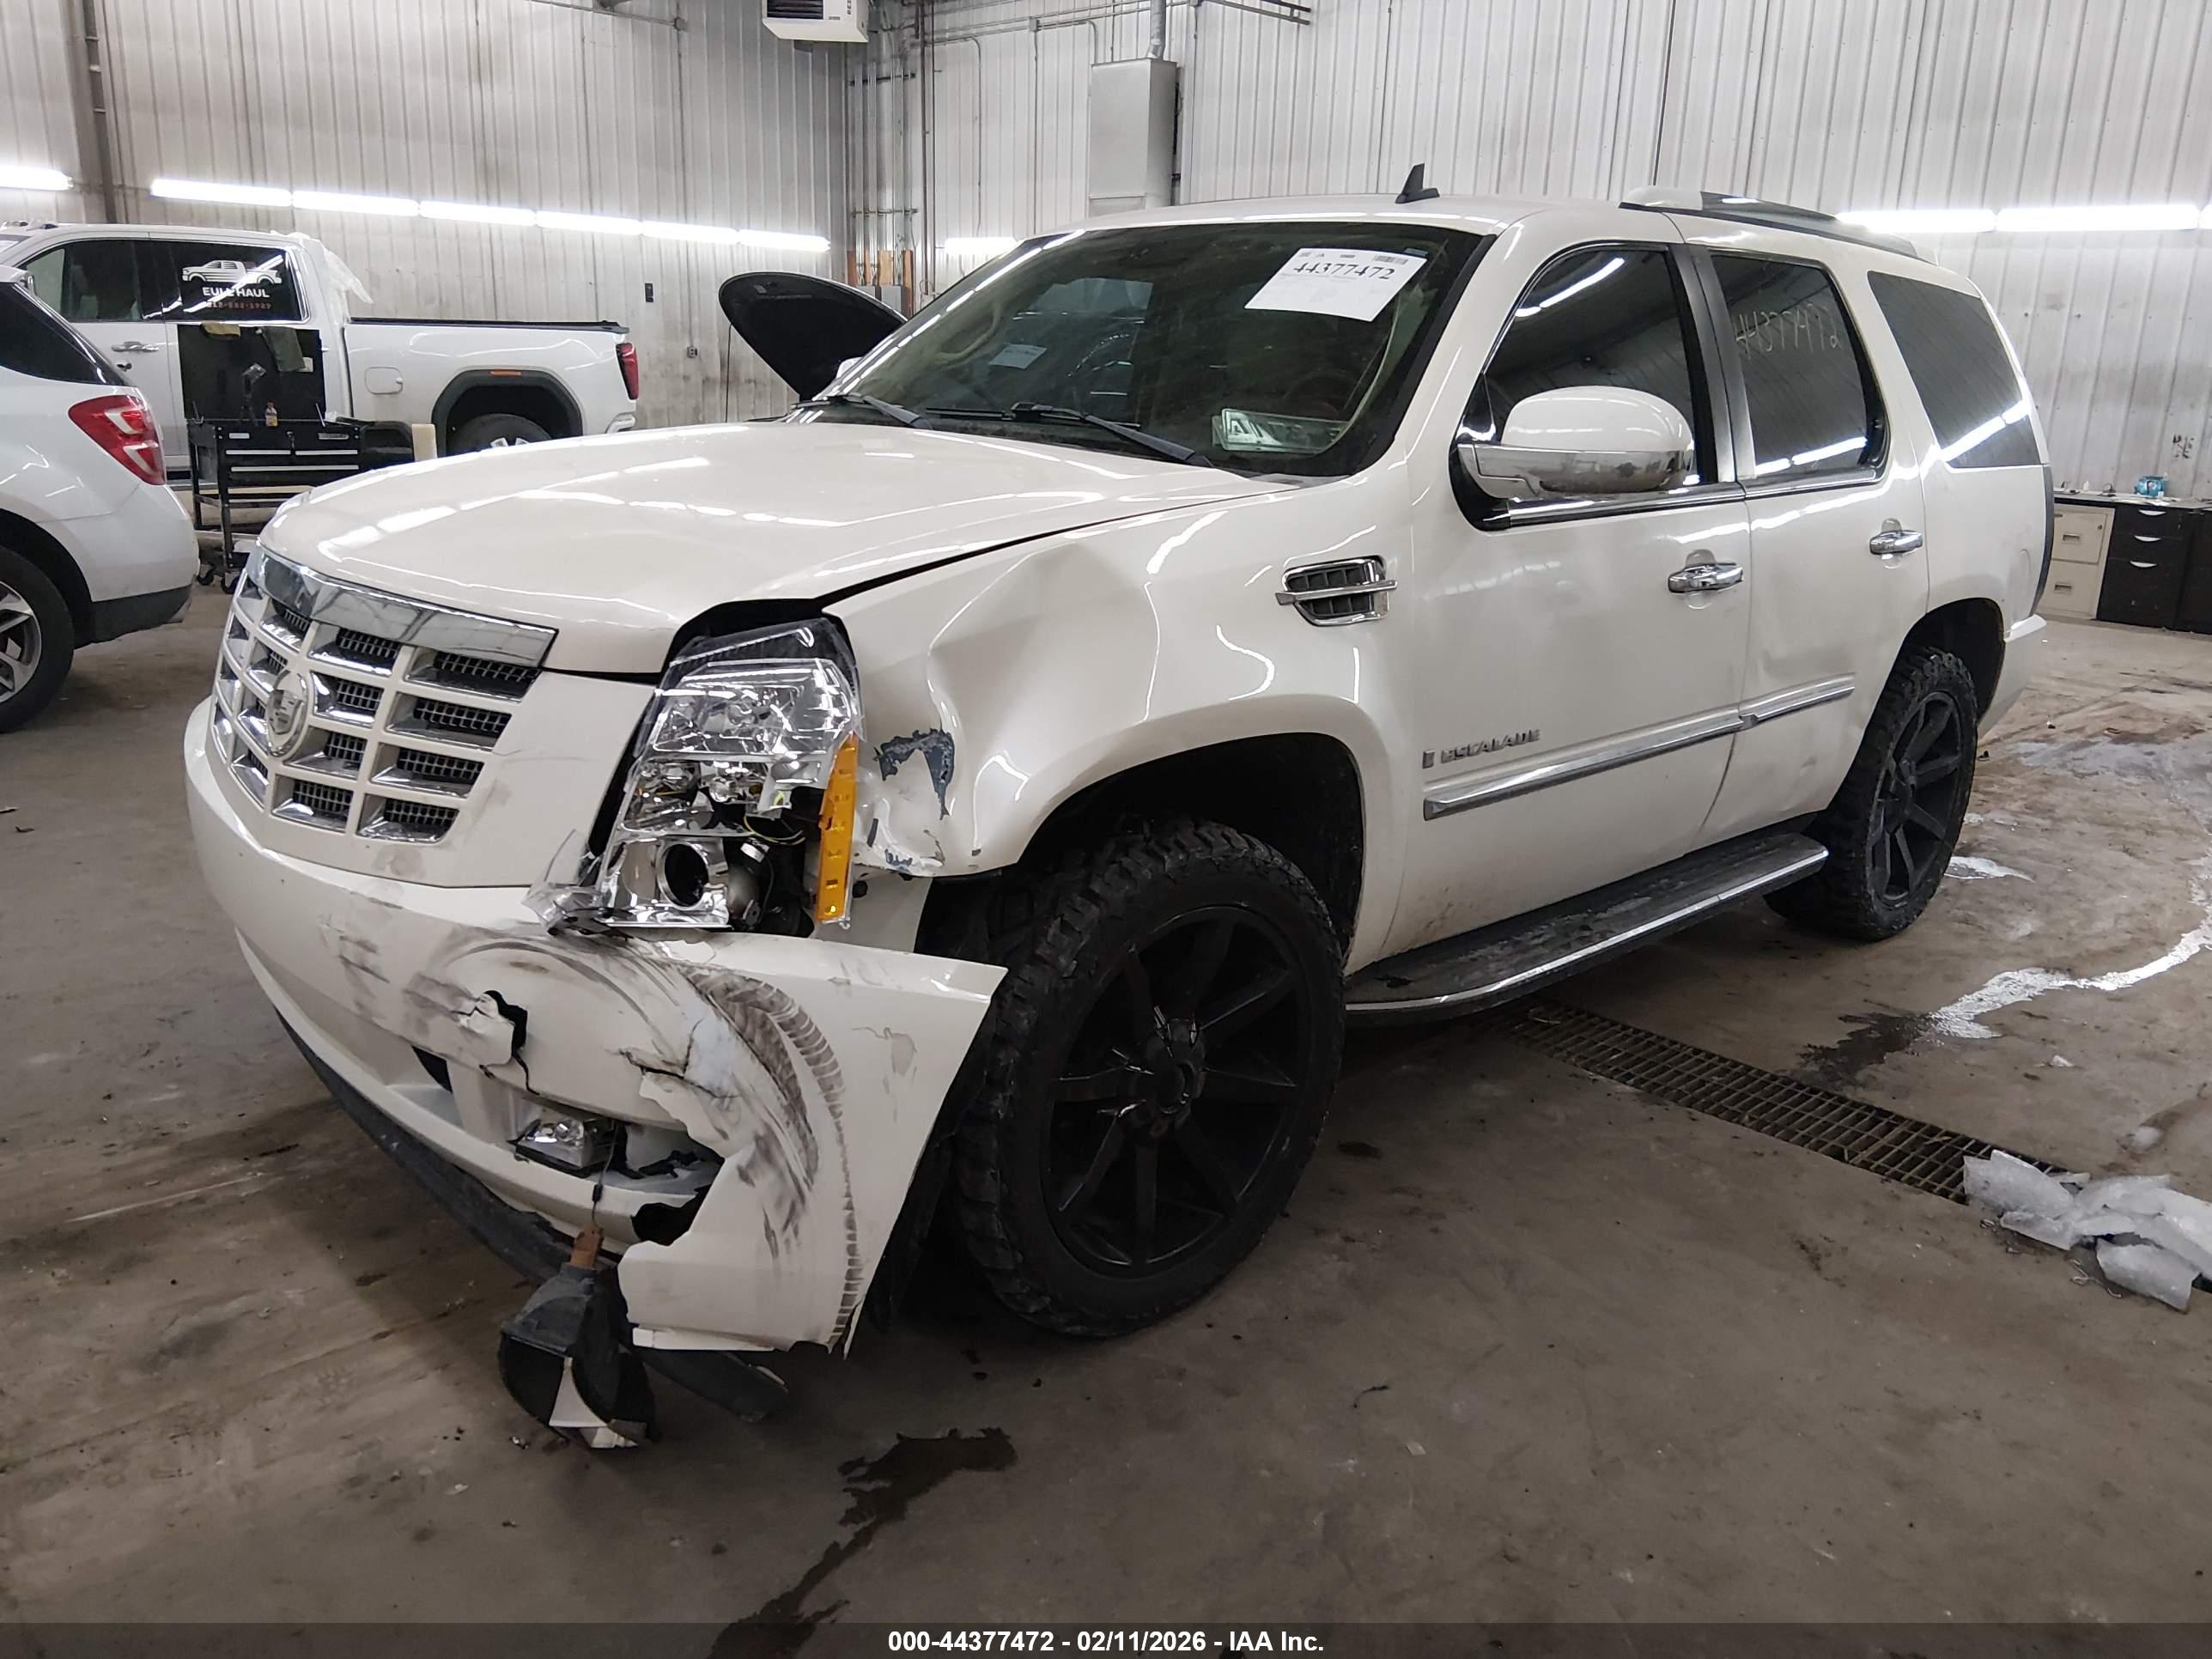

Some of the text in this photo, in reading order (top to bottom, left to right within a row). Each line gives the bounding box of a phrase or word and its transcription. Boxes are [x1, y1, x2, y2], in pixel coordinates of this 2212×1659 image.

[1293, 262, 1395, 280] 44377472
[236, 288, 270, 297] HAUL
[1440, 729, 1541, 763] ESCALADE
